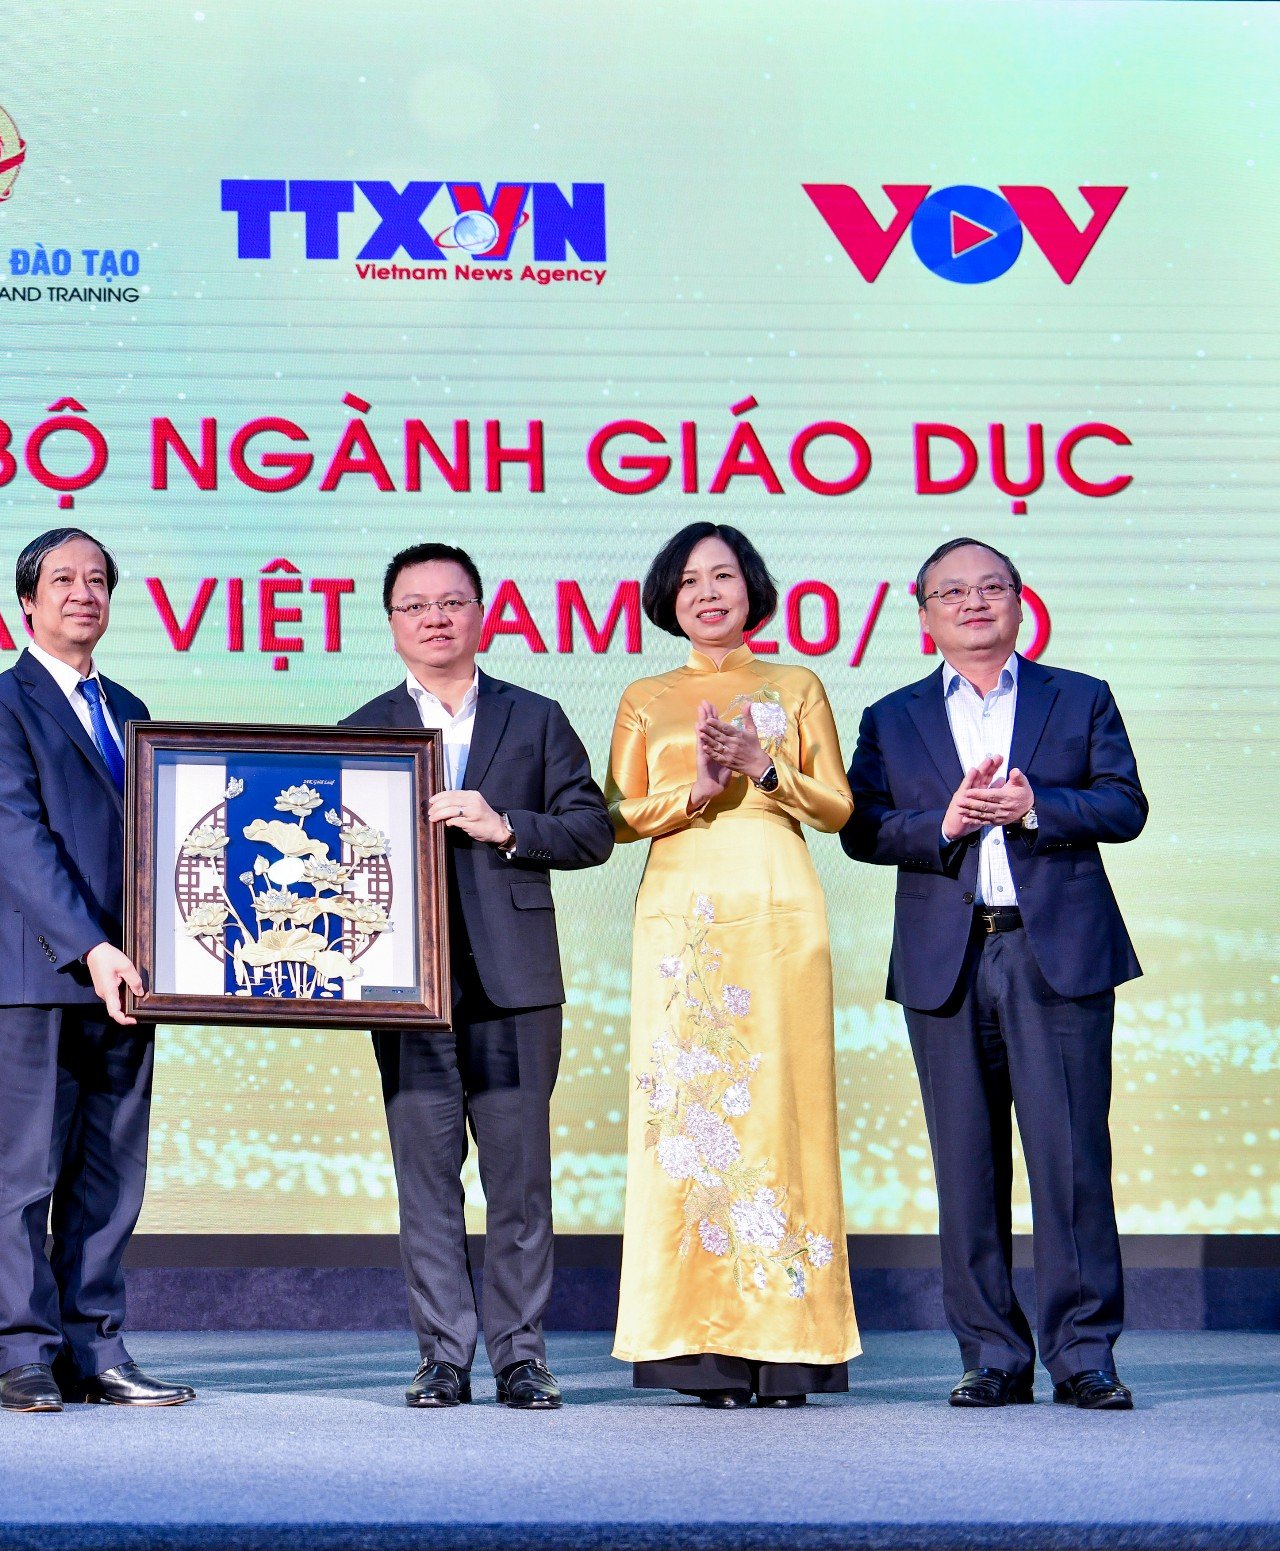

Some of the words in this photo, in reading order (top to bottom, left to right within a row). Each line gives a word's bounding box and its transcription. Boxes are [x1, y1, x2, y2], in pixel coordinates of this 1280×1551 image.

[8, 241, 73, 277] ĐÀO
[81, 248, 141, 283] TẠO
[220, 178, 608, 263] TTXVN
[802, 182, 1128, 286] VOV
[47, 287, 140, 303] TRAINING
[355, 263, 448, 281] Vietnam
[454, 264, 513, 281] News
[520, 265, 607, 285] Agency
[150, 391, 545, 493] NGÀNH
[586, 395, 873, 496] GIÁO
[913, 421, 1134, 515] DỤC
[144, 557, 355, 671] VIỆT
[479, 579, 643, 654] AM
